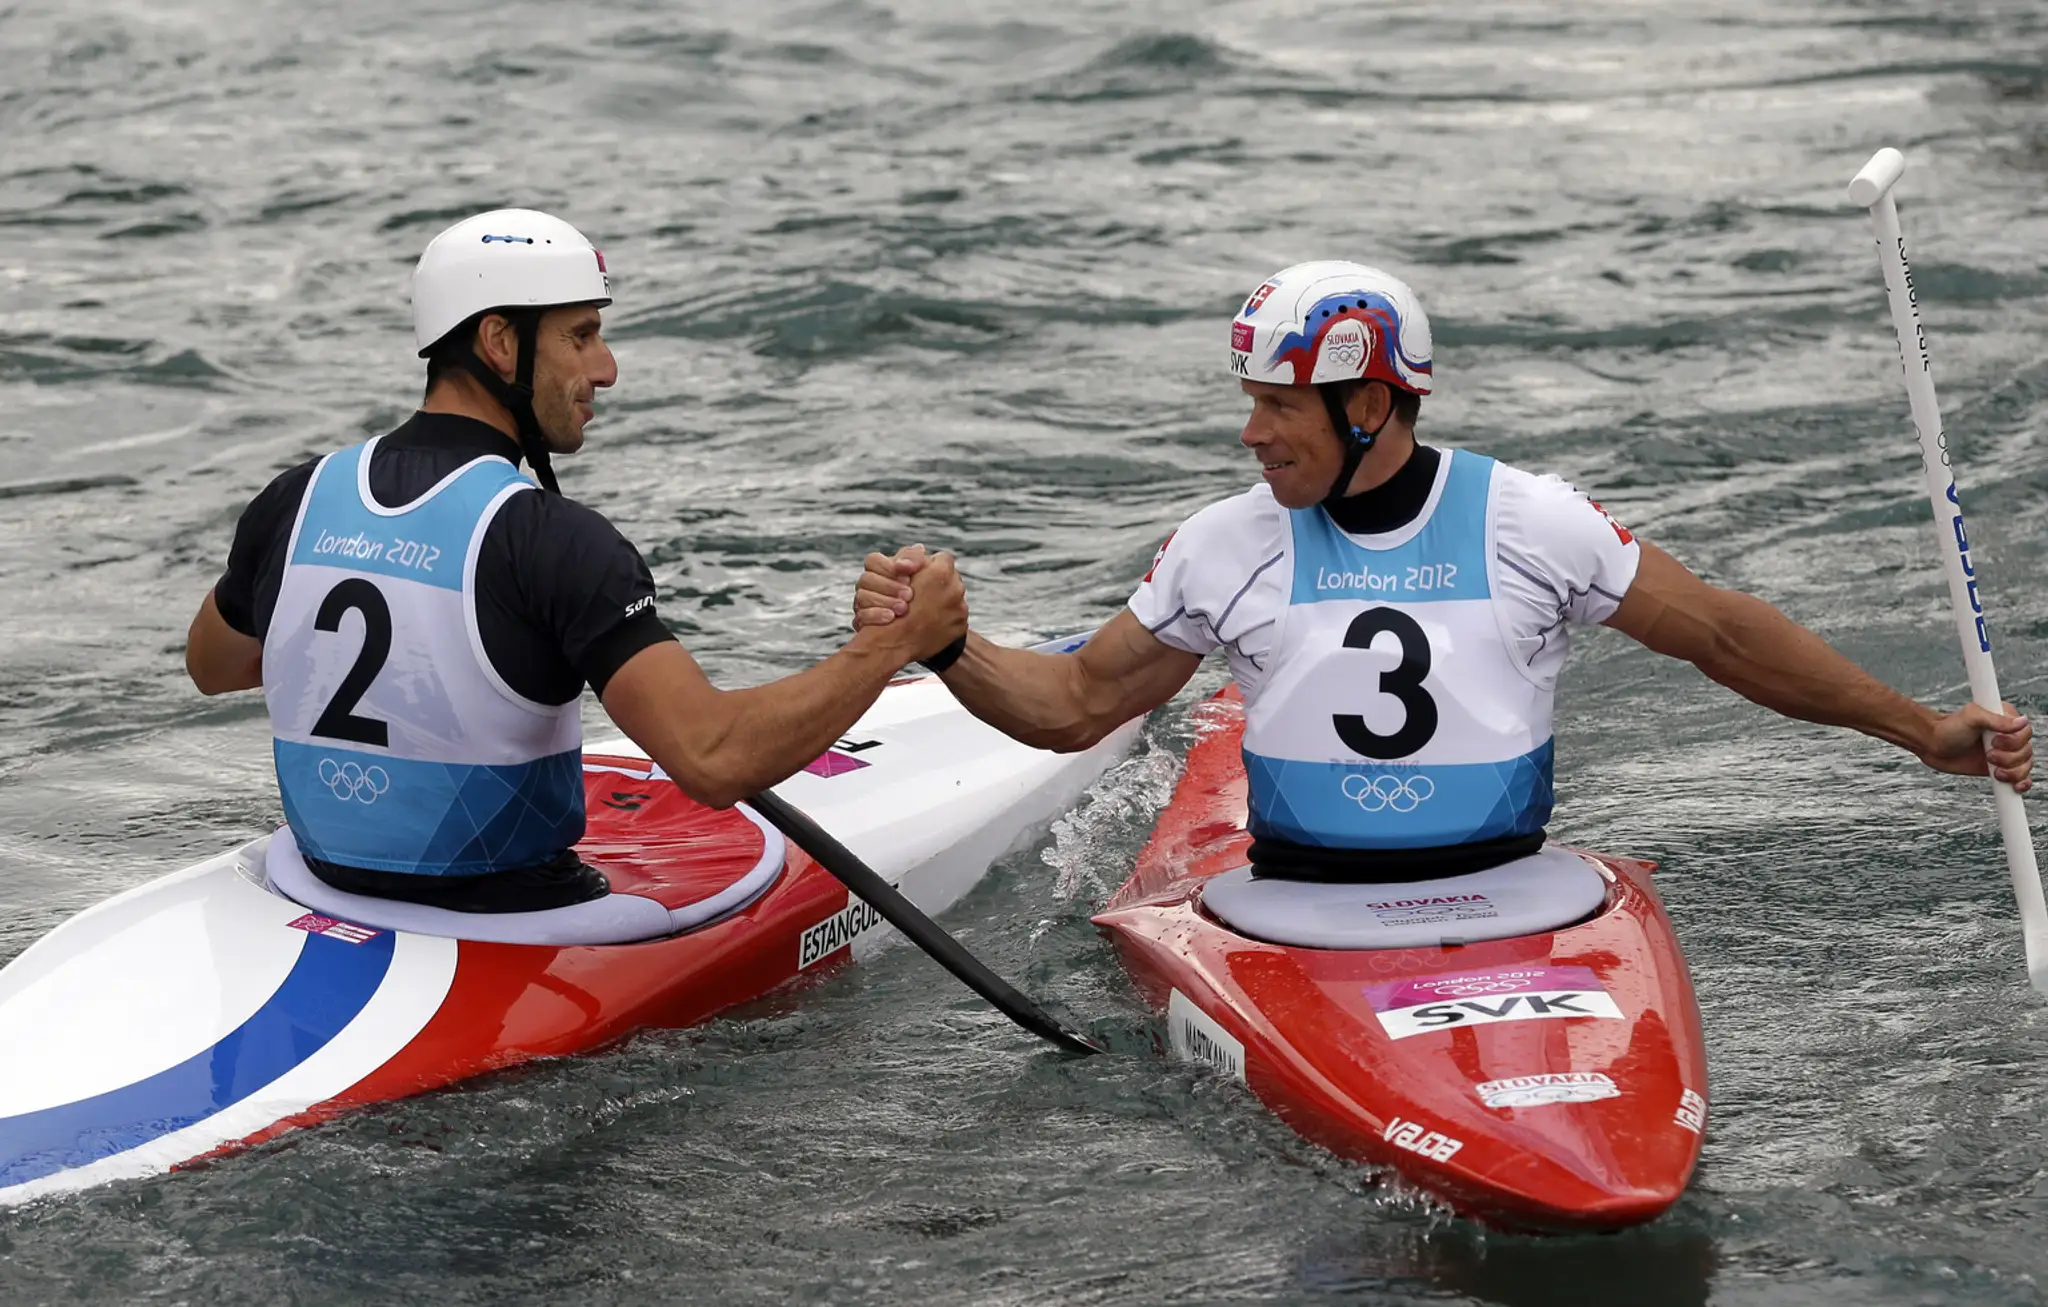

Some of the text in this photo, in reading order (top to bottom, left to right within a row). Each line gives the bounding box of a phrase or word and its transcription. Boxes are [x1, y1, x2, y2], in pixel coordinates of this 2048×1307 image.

[1327, 332, 1360, 346] SLOVAKIA
[313, 528, 441, 573] London 2012
[1316, 562, 1458, 593] London 2012
[310, 577, 393, 748] 2
[1332, 606, 1438, 760] 3
[1366, 893, 1488, 909] SLOVAKIA
[802, 901, 884, 966] ESTANGUE
[1413, 970, 1546, 990] London 2012
[1412, 993, 1594, 1027] SVK
[1481, 1072, 1609, 1092] SLOVAKIA
